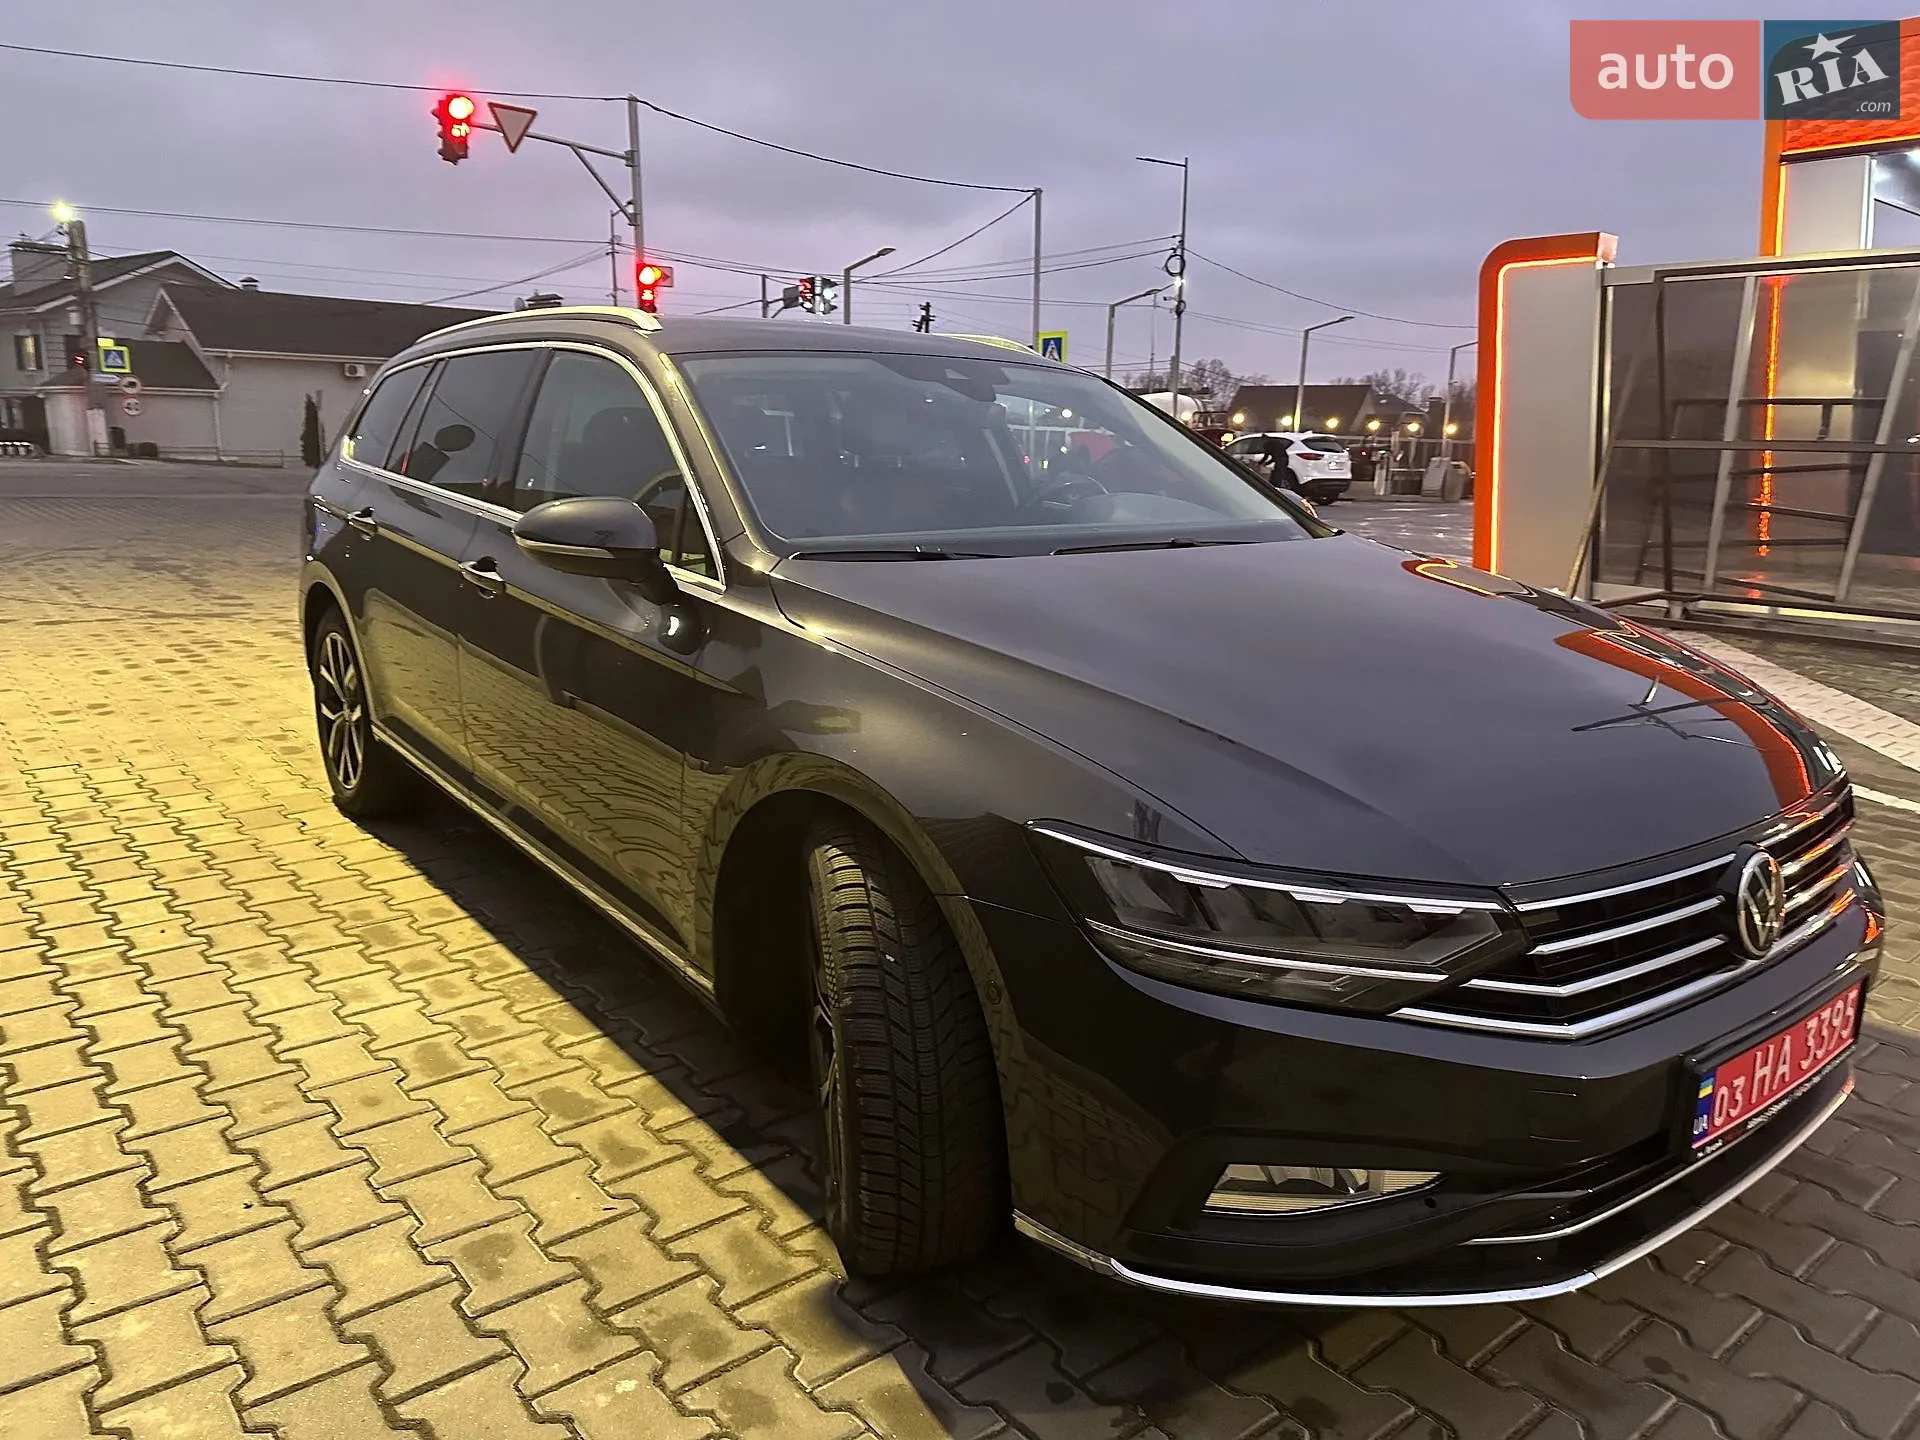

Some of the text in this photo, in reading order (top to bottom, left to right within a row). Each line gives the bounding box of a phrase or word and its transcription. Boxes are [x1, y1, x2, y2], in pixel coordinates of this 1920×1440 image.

[1714, 1076, 1746, 1127] 03
[1751, 1035, 1792, 1104] HA
[1800, 988, 1859, 1070] 3395
